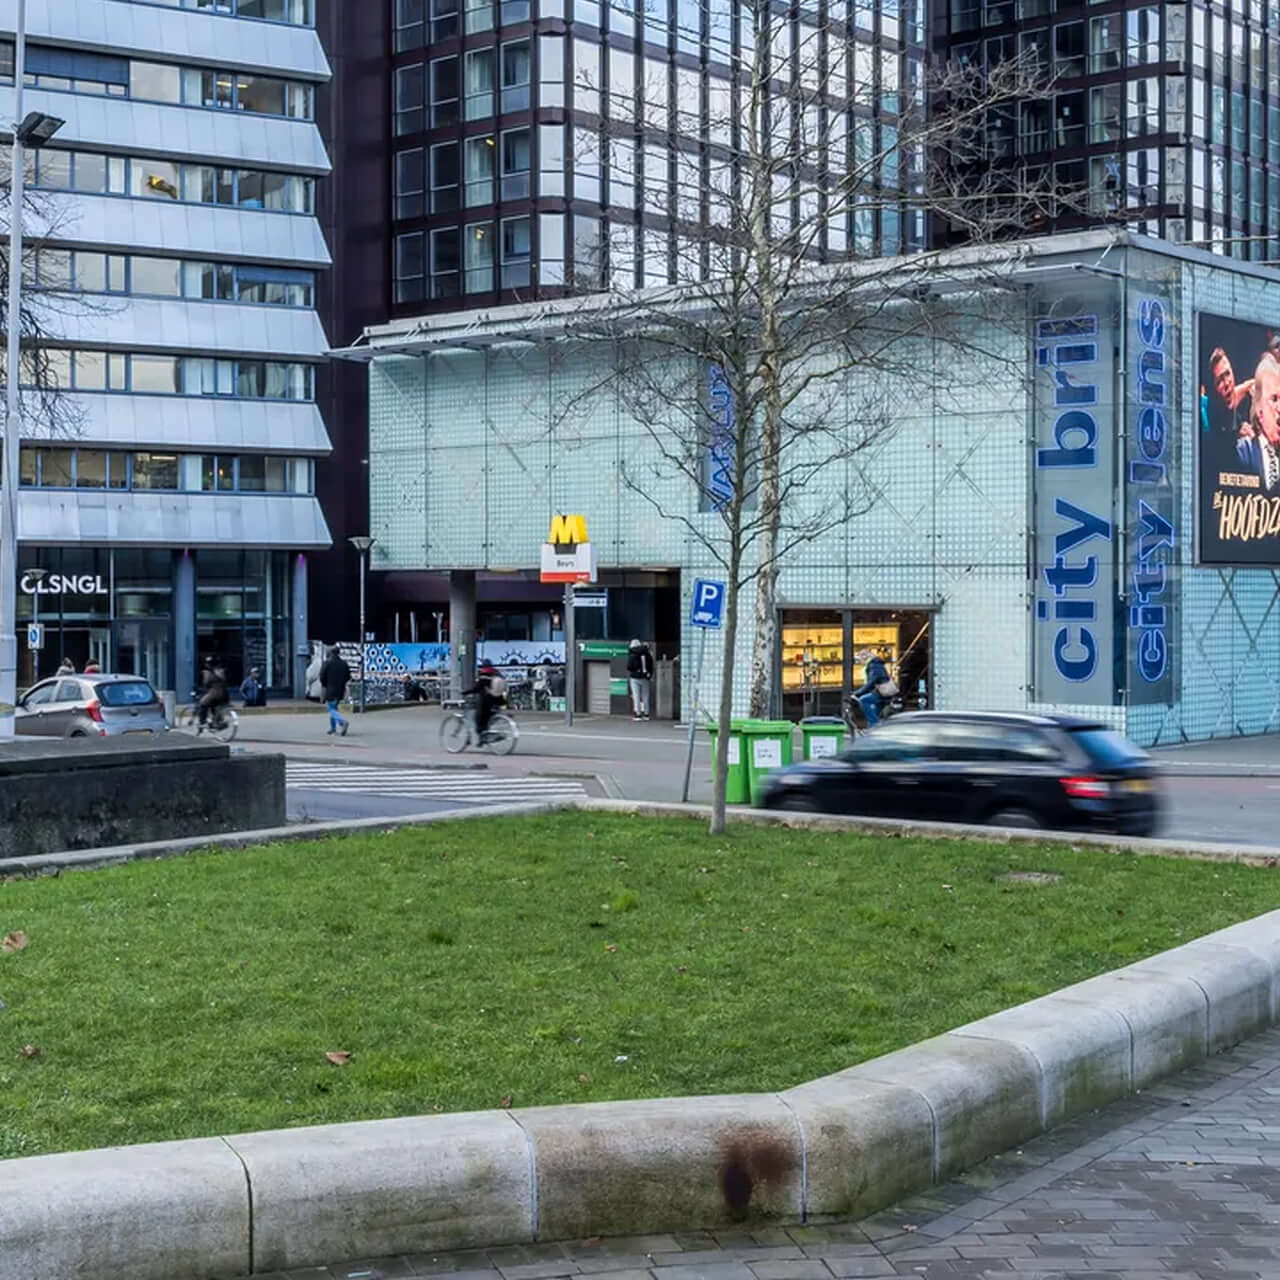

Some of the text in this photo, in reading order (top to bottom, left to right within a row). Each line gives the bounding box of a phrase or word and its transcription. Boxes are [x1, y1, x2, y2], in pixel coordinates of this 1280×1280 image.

[20, 574, 108, 594] CLSNGL
[1036, 315, 1112, 683] city bril
[1130, 299, 1175, 682] city lens
[700, 585, 718, 607] P
